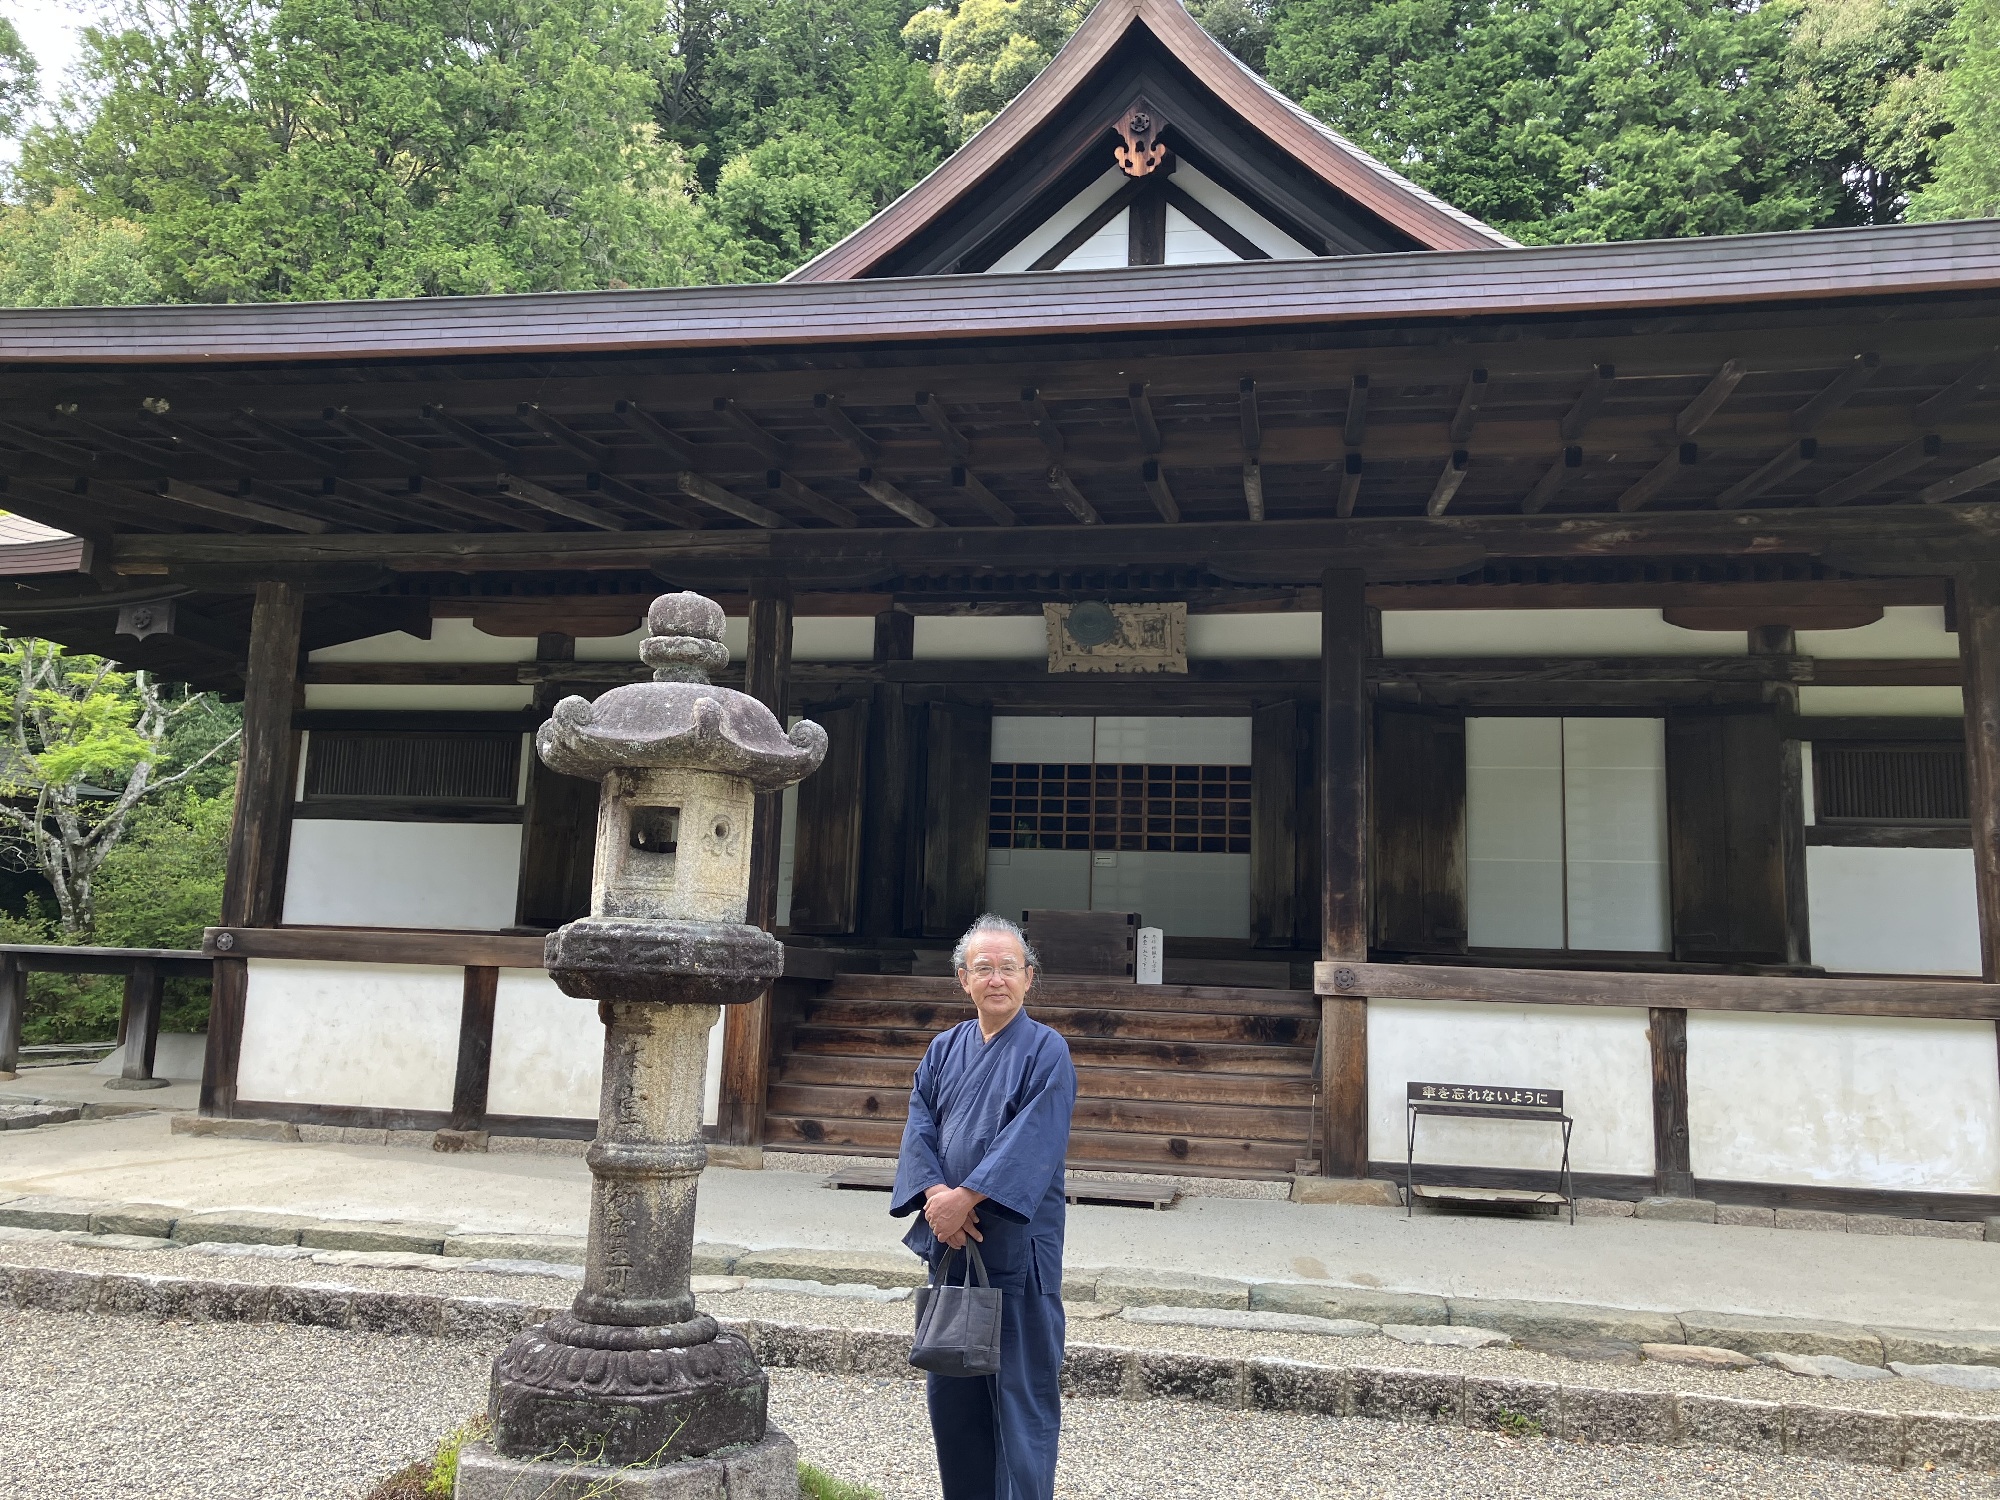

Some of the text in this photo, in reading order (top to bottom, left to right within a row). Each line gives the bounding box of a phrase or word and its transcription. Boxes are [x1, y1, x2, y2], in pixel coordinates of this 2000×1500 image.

[1422, 1086, 1548, 1104] 傘を忘れないように
